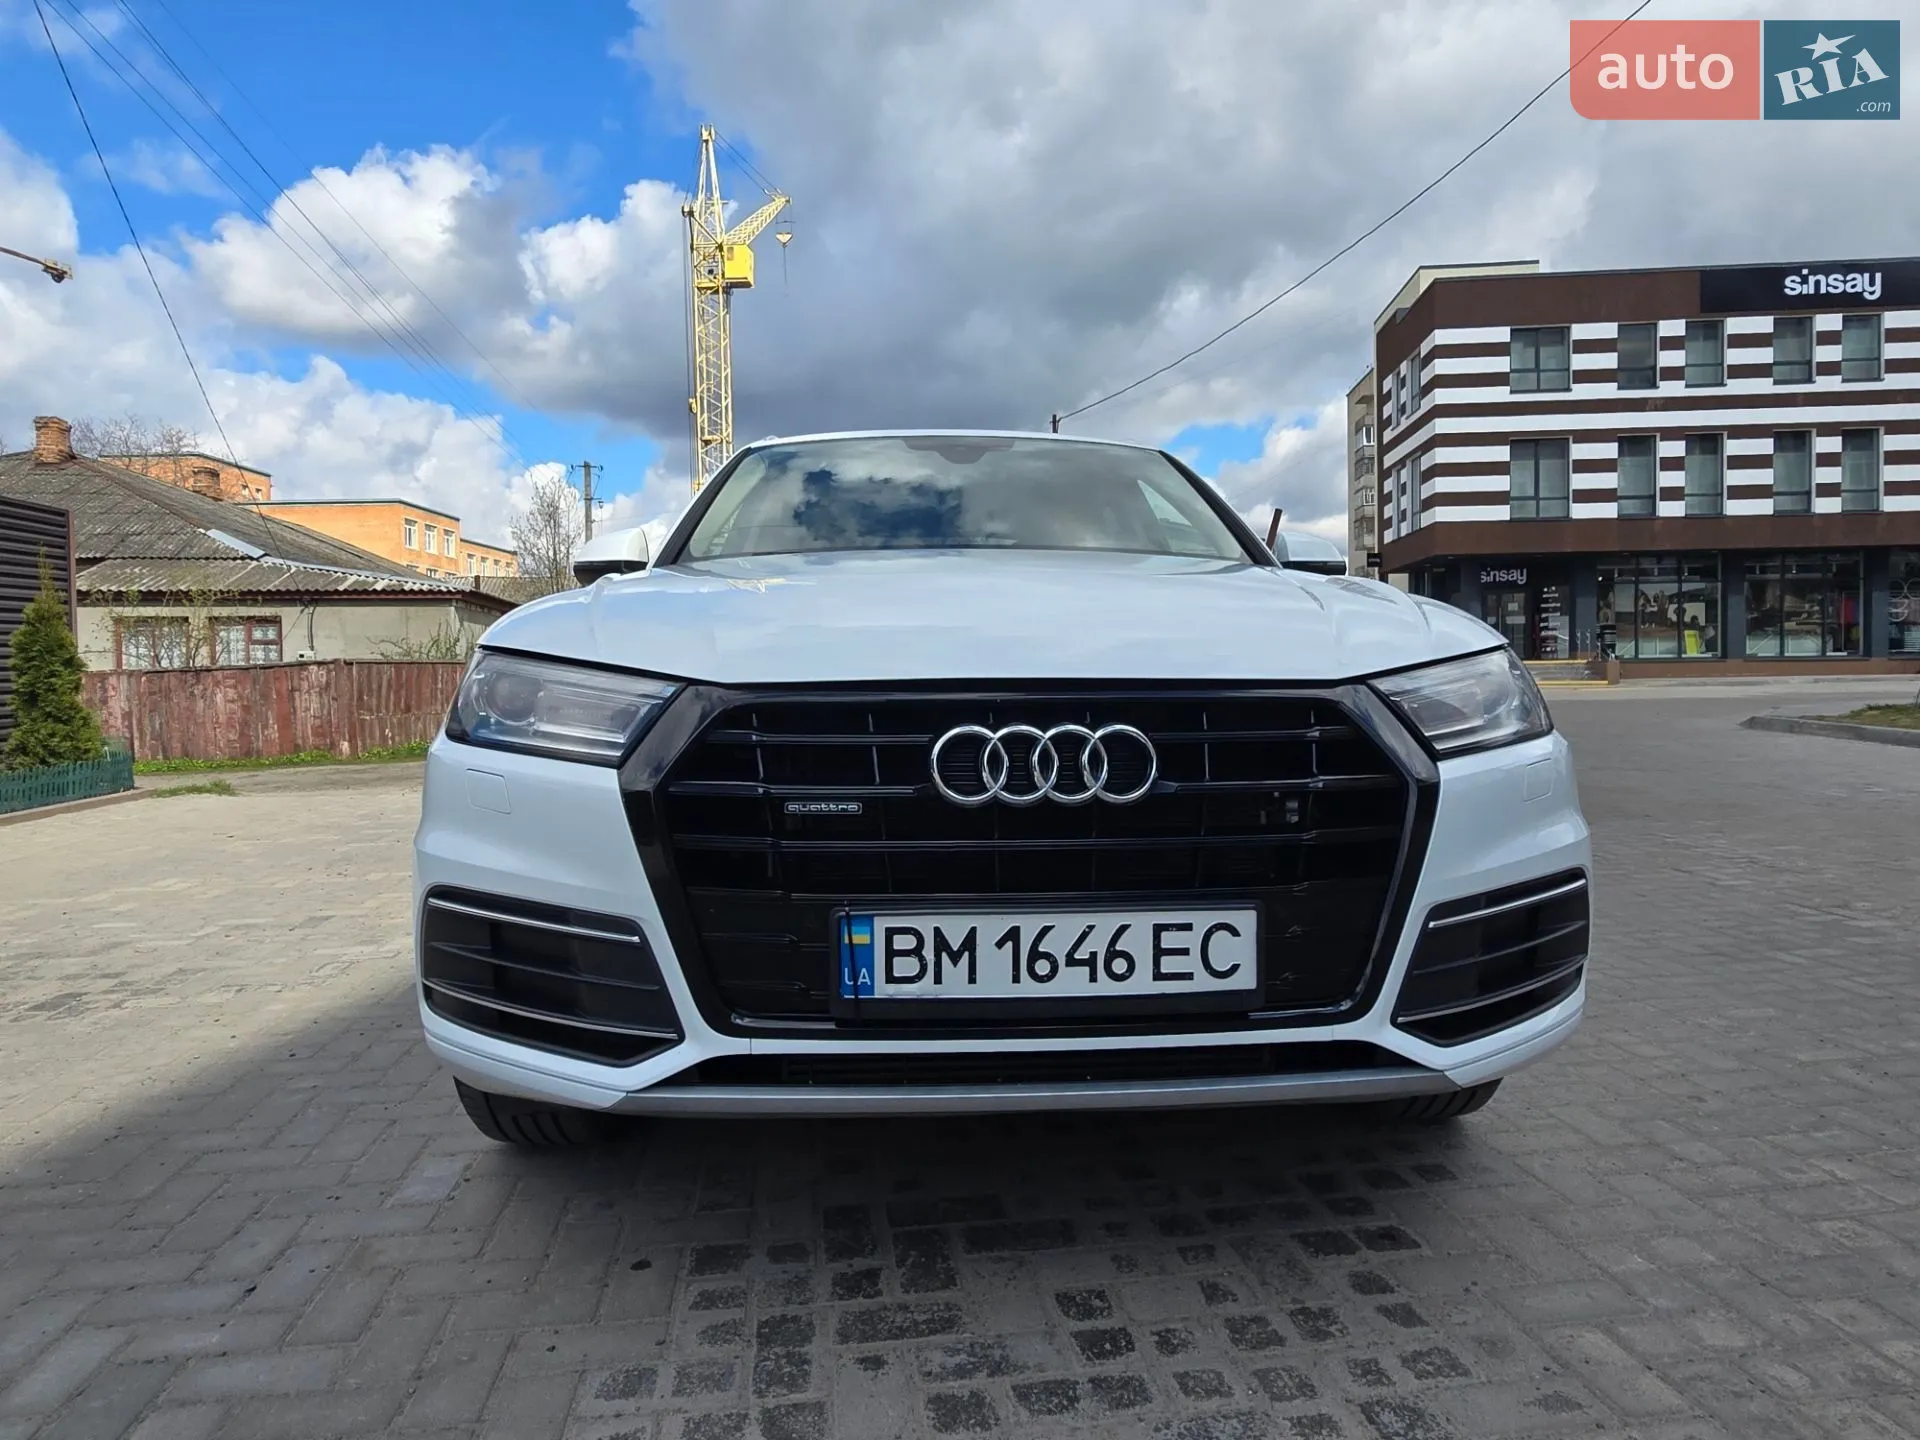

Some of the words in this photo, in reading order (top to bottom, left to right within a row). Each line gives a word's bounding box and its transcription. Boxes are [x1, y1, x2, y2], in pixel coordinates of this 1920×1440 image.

[1783, 268, 1882, 300] sinsay
[1480, 567, 1527, 585] sinsay
[787, 803, 858, 813] quattro
[884, 925, 978, 985] BM
[994, 923, 1136, 985] 1646
[1152, 922, 1242, 982] EC
[844, 967, 871, 986] UA
